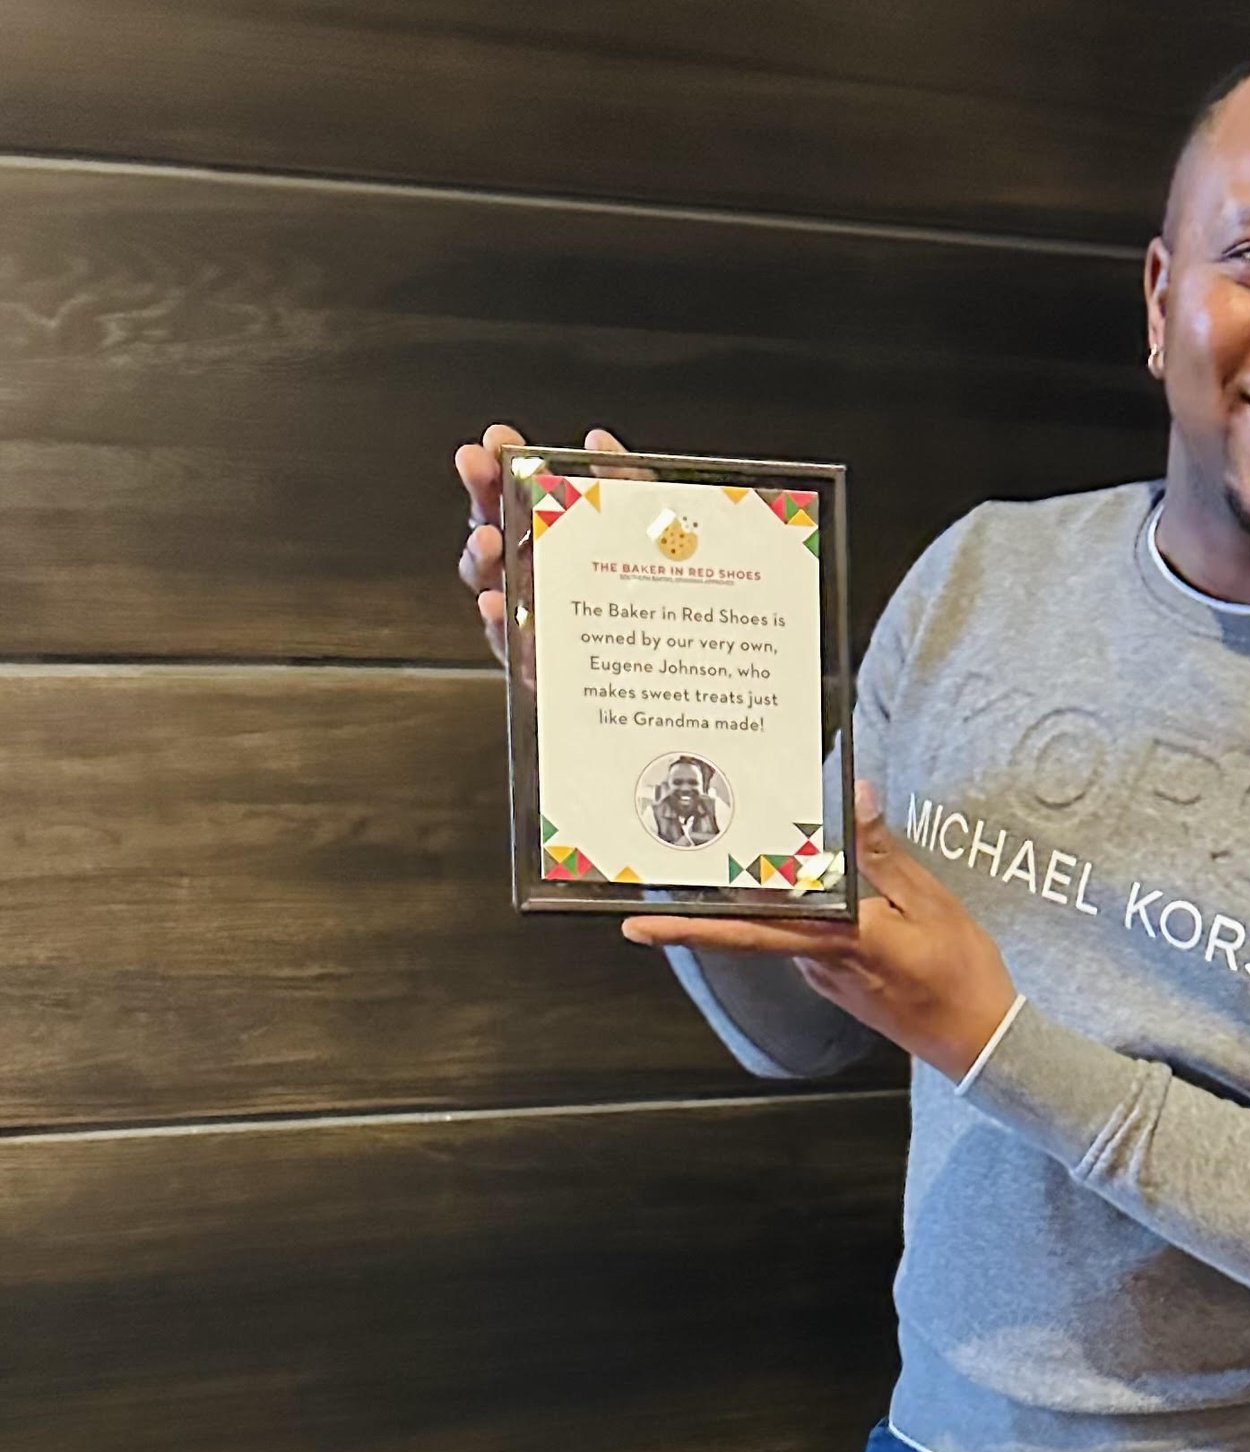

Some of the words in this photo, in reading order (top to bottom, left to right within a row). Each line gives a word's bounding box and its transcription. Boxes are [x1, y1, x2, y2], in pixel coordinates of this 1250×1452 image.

[592, 561, 618, 573] THE
[622, 563, 666, 575] BAKER
[670, 566, 684, 577] IN
[688, 567, 715, 579] RED
[718, 569, 762, 581] SHOES
[571, 601, 602, 617] The
[608, 602, 656, 620] Baker
[662, 606, 676, 621] in
[682, 607, 714, 623] Red
[719, 609, 768, 626] Shoes
[773, 612, 785, 627] is
[581, 630, 636, 646] owned
[642, 631, 661, 650] by
[667, 636, 694, 648] our
[700, 637, 735, 655] very
[740, 640, 778, 655] own,
[590, 655, 653, 675] Eugene
[659, 659, 732, 679] Johnson,
[738, 663, 771, 679] who
[584, 683, 636, 699] makes
[641, 689, 690, 701] sweet
[695, 689, 744, 704] treats
[747, 691, 779, 709] just
[598, 709, 628, 725] like
[633, 711, 709, 729] Grandma
[715, 717, 765, 732] made!
[906, 792, 1098, 915] MICHAEL
